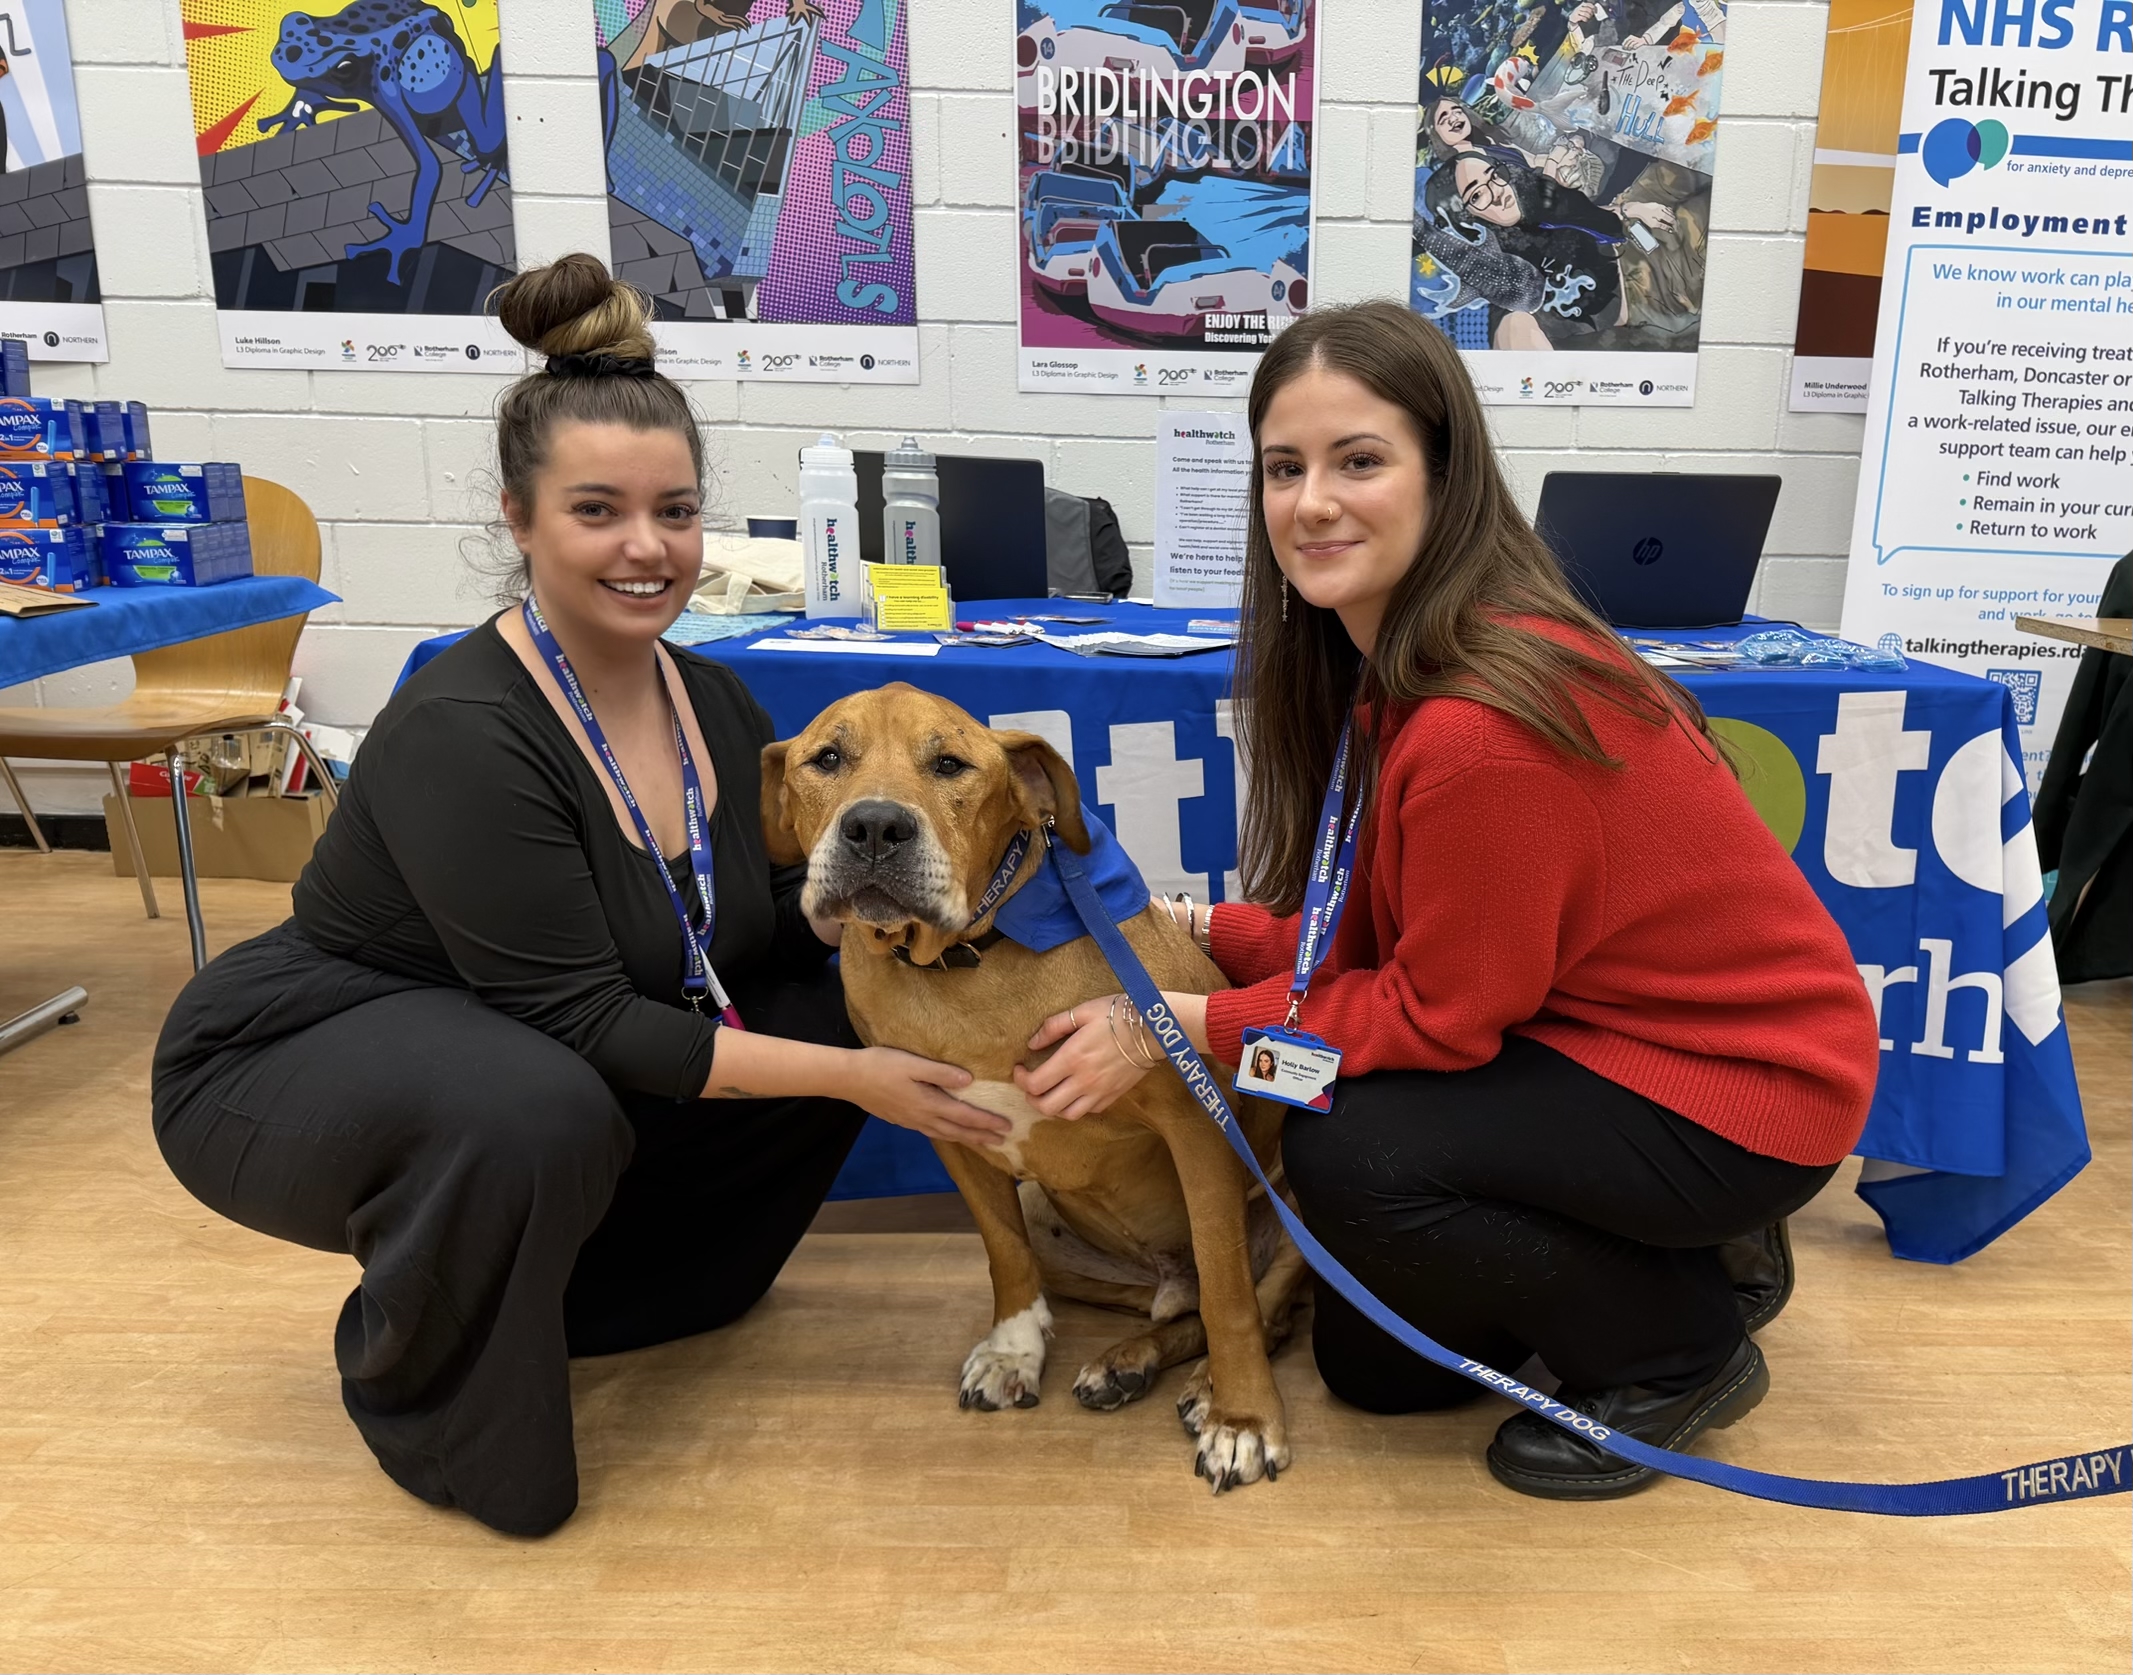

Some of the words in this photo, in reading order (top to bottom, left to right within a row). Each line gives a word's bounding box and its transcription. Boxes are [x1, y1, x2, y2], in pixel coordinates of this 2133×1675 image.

[1937, 0, 2075, 49] NHS
[1038, 65, 1296, 121] BRIDLINGTON
[1929, 67, 2081, 121] Talking
[2006, 160, 2024, 172] for
[2027, 162, 2071, 177] anxiety
[2073, 165, 2096, 176] and
[1911, 206, 2128, 237] Employment
[1933, 263, 1962, 281] We
[1967, 264, 2017, 282] know
[2022, 268, 2065, 285] work
[2070, 273, 2099, 287] can
[2104, 271, 2133, 292] pla
[1996, 292, 2012, 308] in
[2017, 296, 2047, 310] our
[2050, 296, 2111, 314] mental
[1205, 314, 1240, 328] ENJOY
[1243, 315, 1265, 329] THE
[62, 336, 98, 344] NORTHERN
[235, 337, 253, 345] Luke
[254, 337, 281, 345] Hillson
[1205, 332, 1257, 344] Discovering
[245, 347, 271, 355] Diploma
[279, 347, 303, 356] Graphic
[303, 348, 326, 356] Design
[1937, 337, 1950, 353] If
[1954, 340, 2007, 359] you're
[2011, 341, 2087, 363] receiving
[700, 358, 722, 366] Design
[1032, 361, 1048, 369] Lara
[1049, 361, 1078, 370] Glossop
[1041, 371, 1066, 379] Diploma
[1073, 371, 1097, 380] Graphic
[1098, 372, 1119, 380] Design
[1804, 382, 1823, 390] Millie
[1824, 382, 1867, 390] Underwood
[1920, 362, 2018, 384] Rotherham,
[2023, 367, 2109, 388] Doncaster
[2113, 373, 2133, 387] or
[1812, 391, 1836, 400] Diploma
[1844, 392, 1868, 401] Graphic
[1959, 389, 2017, 411] Talking
[2021, 392, 2103, 415] Therapies
[1174, 429, 1235, 439] healthwatch
[1907, 414, 1918, 428] a
[1924, 414, 2031, 434] work-related
[2035, 417, 2081, 437] issue,
[2086, 423, 2117, 437] our
[1939, 441, 2004, 459] support
[2009, 443, 2051, 459] team
[2055, 446, 2084, 460] can
[2088, 443, 2126, 465] help
[143, 483, 191, 495] TAMPAX
[1976, 470, 2012, 488] Find
[2016, 472, 2061, 489] work
[1973, 495, 2035, 513] Remain
[2040, 498, 2055, 514] in
[2060, 500, 2100, 518] your
[1970, 520, 2026, 537] Return
[2030, 522, 2048, 538] to
[2053, 523, 2097, 540] work
[123, 548, 176, 560] TAMPAX
[826, 518, 841, 602] healthwatch
[1196, 553, 1214, 561] here
[1225, 554, 1243, 563] help
[1635, 538, 1661, 564] hp
[1170, 566, 1192, 574] listen
[1194, 567, 1202, 575] to
[1203, 568, 1222, 576] your
[1882, 583, 1898, 596] To
[1902, 584, 1931, 601] sign
[1936, 586, 1954, 602] up
[1958, 586, 1979, 599] for
[1983, 588, 2038, 604] support
[2042, 588, 2064, 602] for
[2067, 591, 2101, 607] your
[1978, 608, 2005, 621] and
[555, 653, 593, 721] healthwatch
[601, 743, 636, 807] healthwatch
[686, 787, 702, 852] healthwatch
[1318, 815, 1339, 883] healthwatch
[683, 914, 702, 976] healthwatch
[1301, 906, 1322, 974] healthwatch
[1146, 1003, 1183, 1048] DOG
[1282, 1060, 1297, 1069] Holly
[1299, 1064, 1320, 1074] Barlow
[1171, 1047, 1229, 1132] THERAPY
[1459, 1358, 1560, 1410] THERAPY
[1554, 1409, 1611, 1440] DOG
[2001, 1451, 2122, 1501] THERAPY
